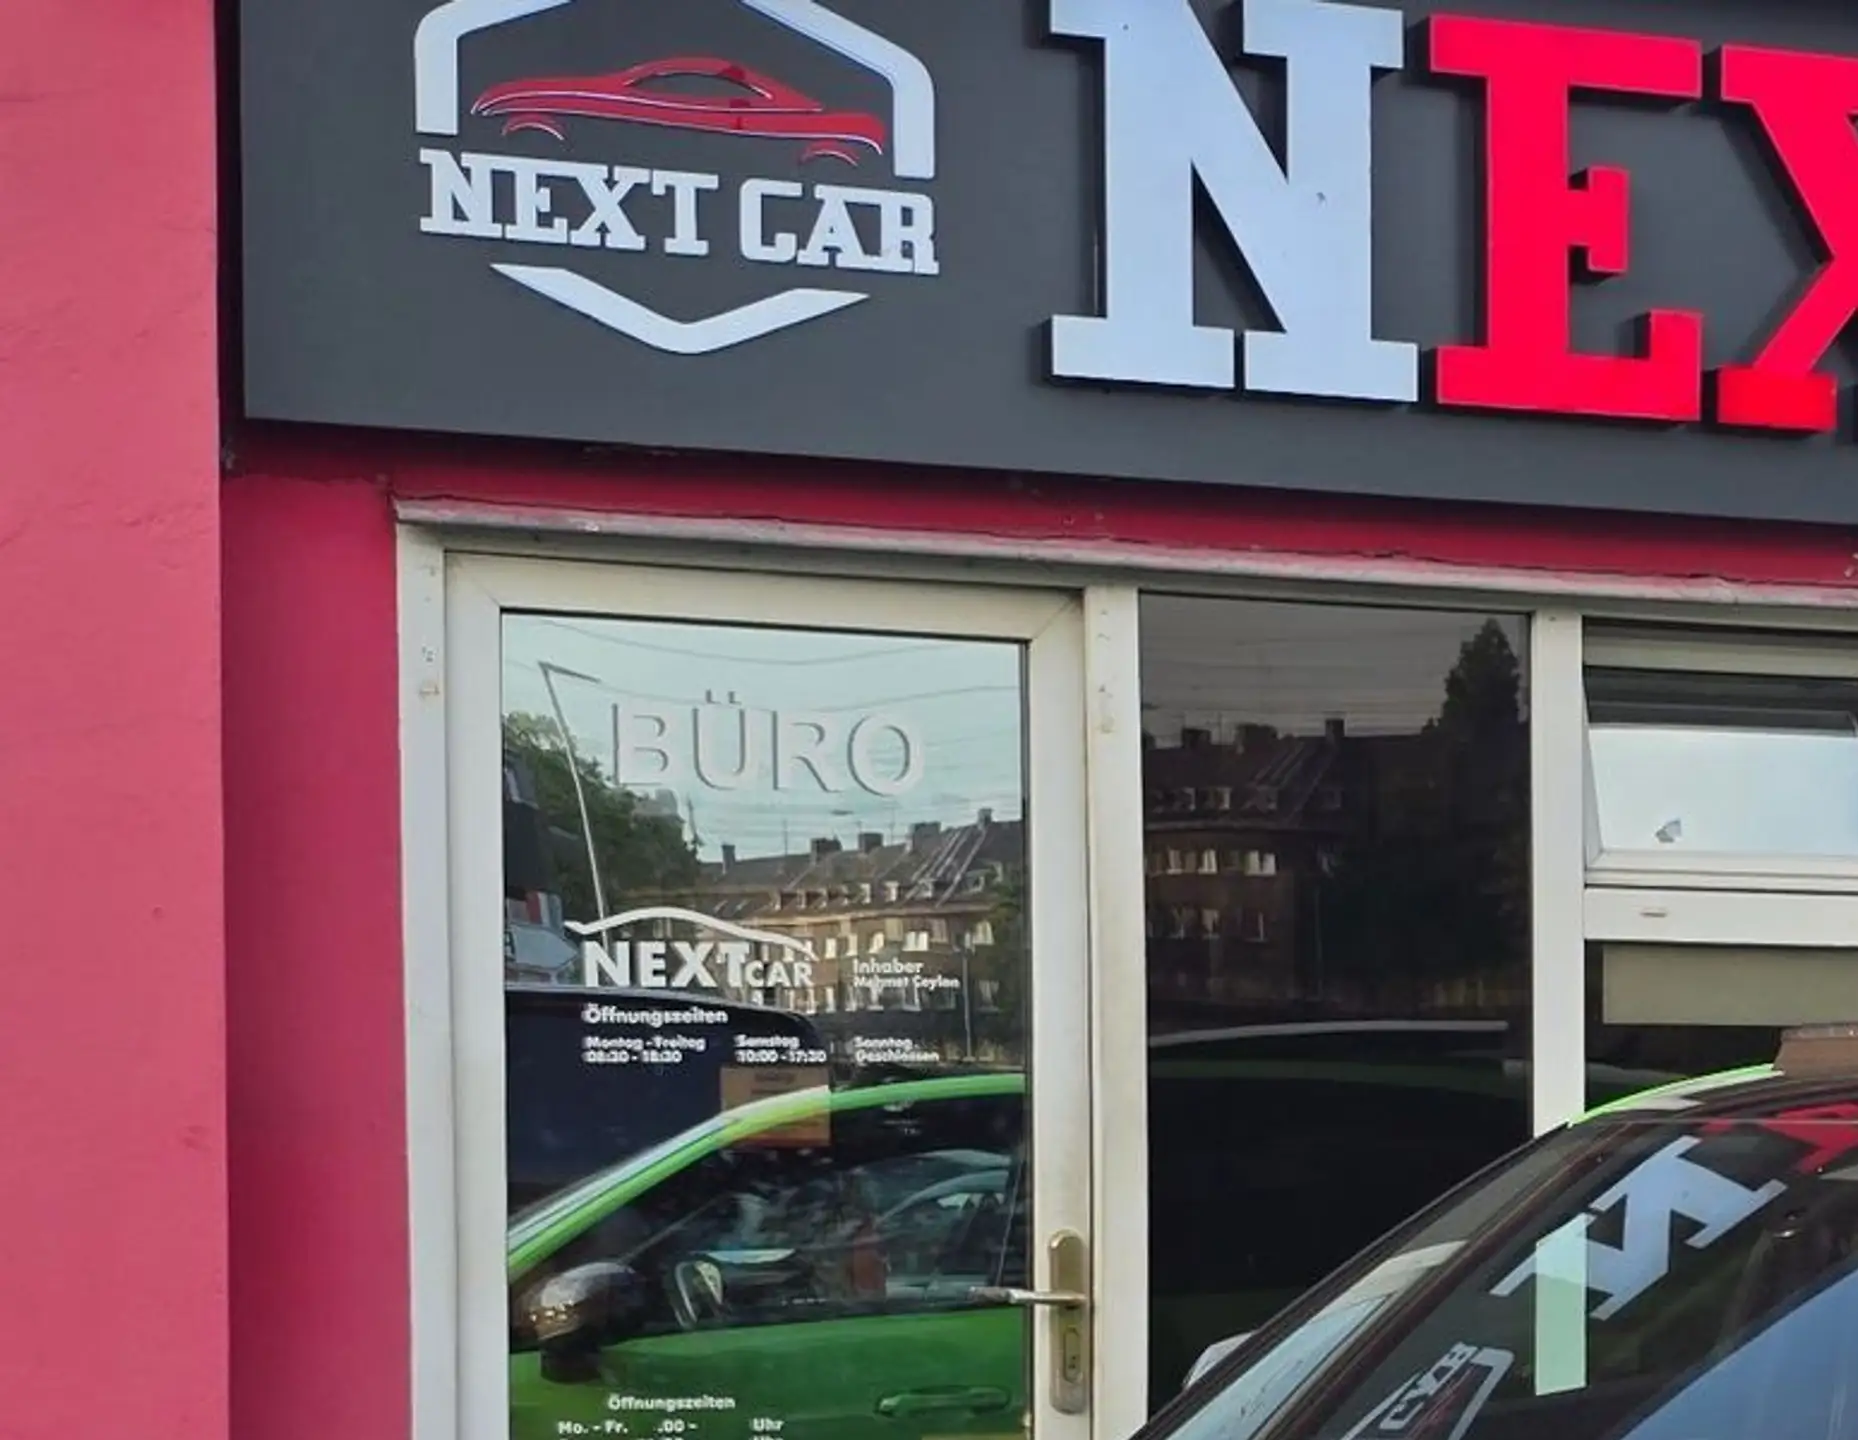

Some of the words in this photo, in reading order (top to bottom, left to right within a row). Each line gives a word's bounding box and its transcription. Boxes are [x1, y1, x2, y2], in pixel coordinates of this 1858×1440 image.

[419, 147, 719, 256] NEXT
[739, 177, 940, 276] CAR
[612, 688, 926, 798] BÜRO
[853, 957, 925, 974] Inhaber
[581, 1003, 729, 1028] Öffnungszeiten
[582, 1035, 644, 1051] Montag
[652, 1034, 707, 1052] Freitag
[733, 1034, 800, 1050] Samstag
[607, 1394, 737, 1412] Öffnungszeiten
[557, 1420, 589, 1435] Mo.
[603, 1419, 629, 1434] Fr.
[750, 1417, 785, 1432] Uhr
